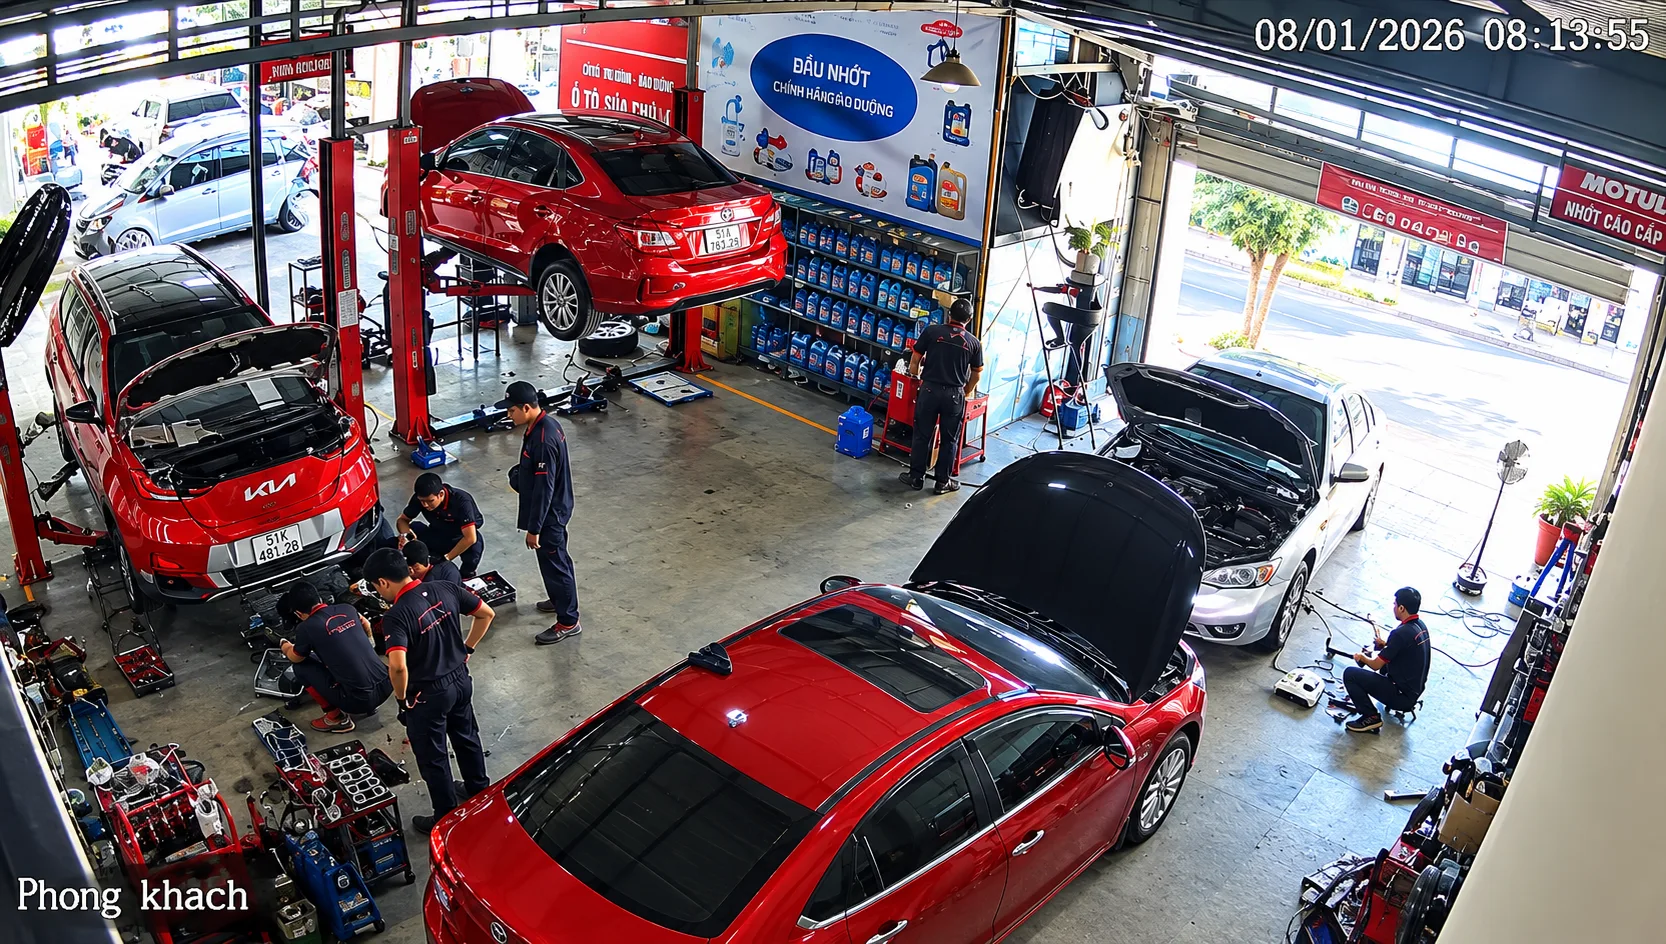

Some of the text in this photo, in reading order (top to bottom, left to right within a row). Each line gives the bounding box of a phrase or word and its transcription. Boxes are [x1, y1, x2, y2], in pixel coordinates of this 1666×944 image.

[793, 54, 871, 88] ĐẦU NHỚT
[773, 79, 804, 98] CHÍNH
[1580, 172, 1666, 216] MOTUL
[265, 529, 288, 547] 51K
[259, 540, 299, 562] 481.28
